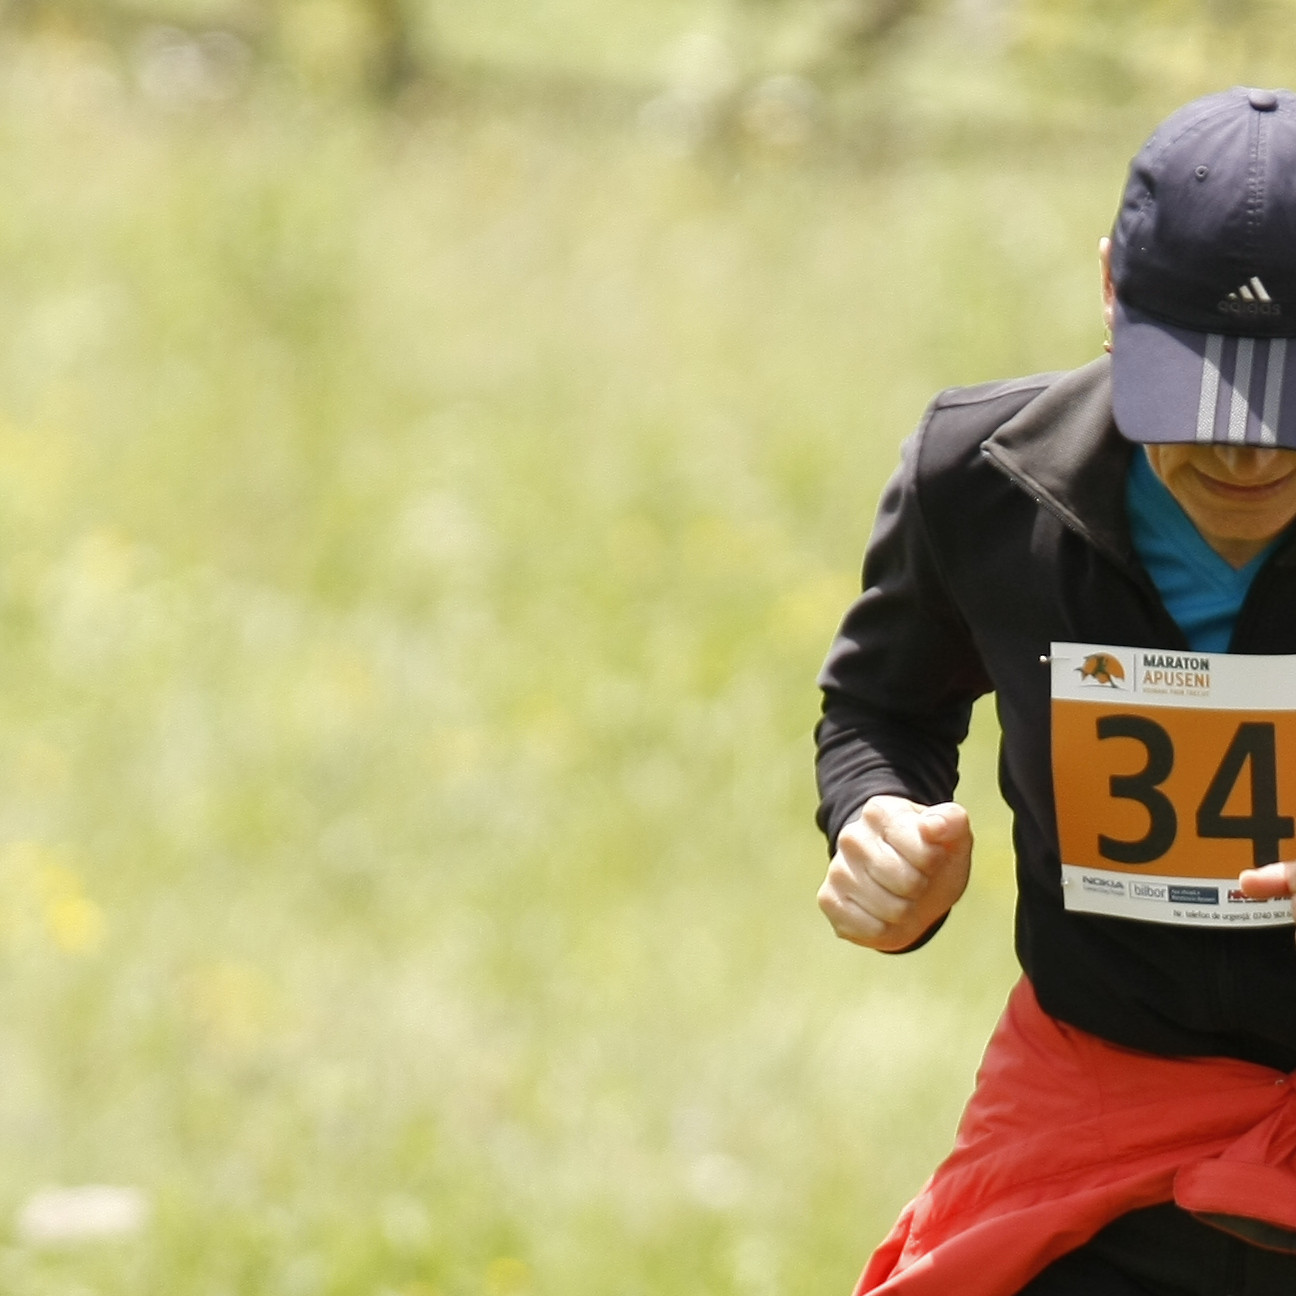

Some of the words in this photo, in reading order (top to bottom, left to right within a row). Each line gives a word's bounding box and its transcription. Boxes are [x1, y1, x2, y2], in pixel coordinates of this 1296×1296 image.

[1143, 654, 1210, 671] MARATON
[1143, 669, 1210, 688] APUSENI
[1082, 875, 1124, 889] NOKIA
